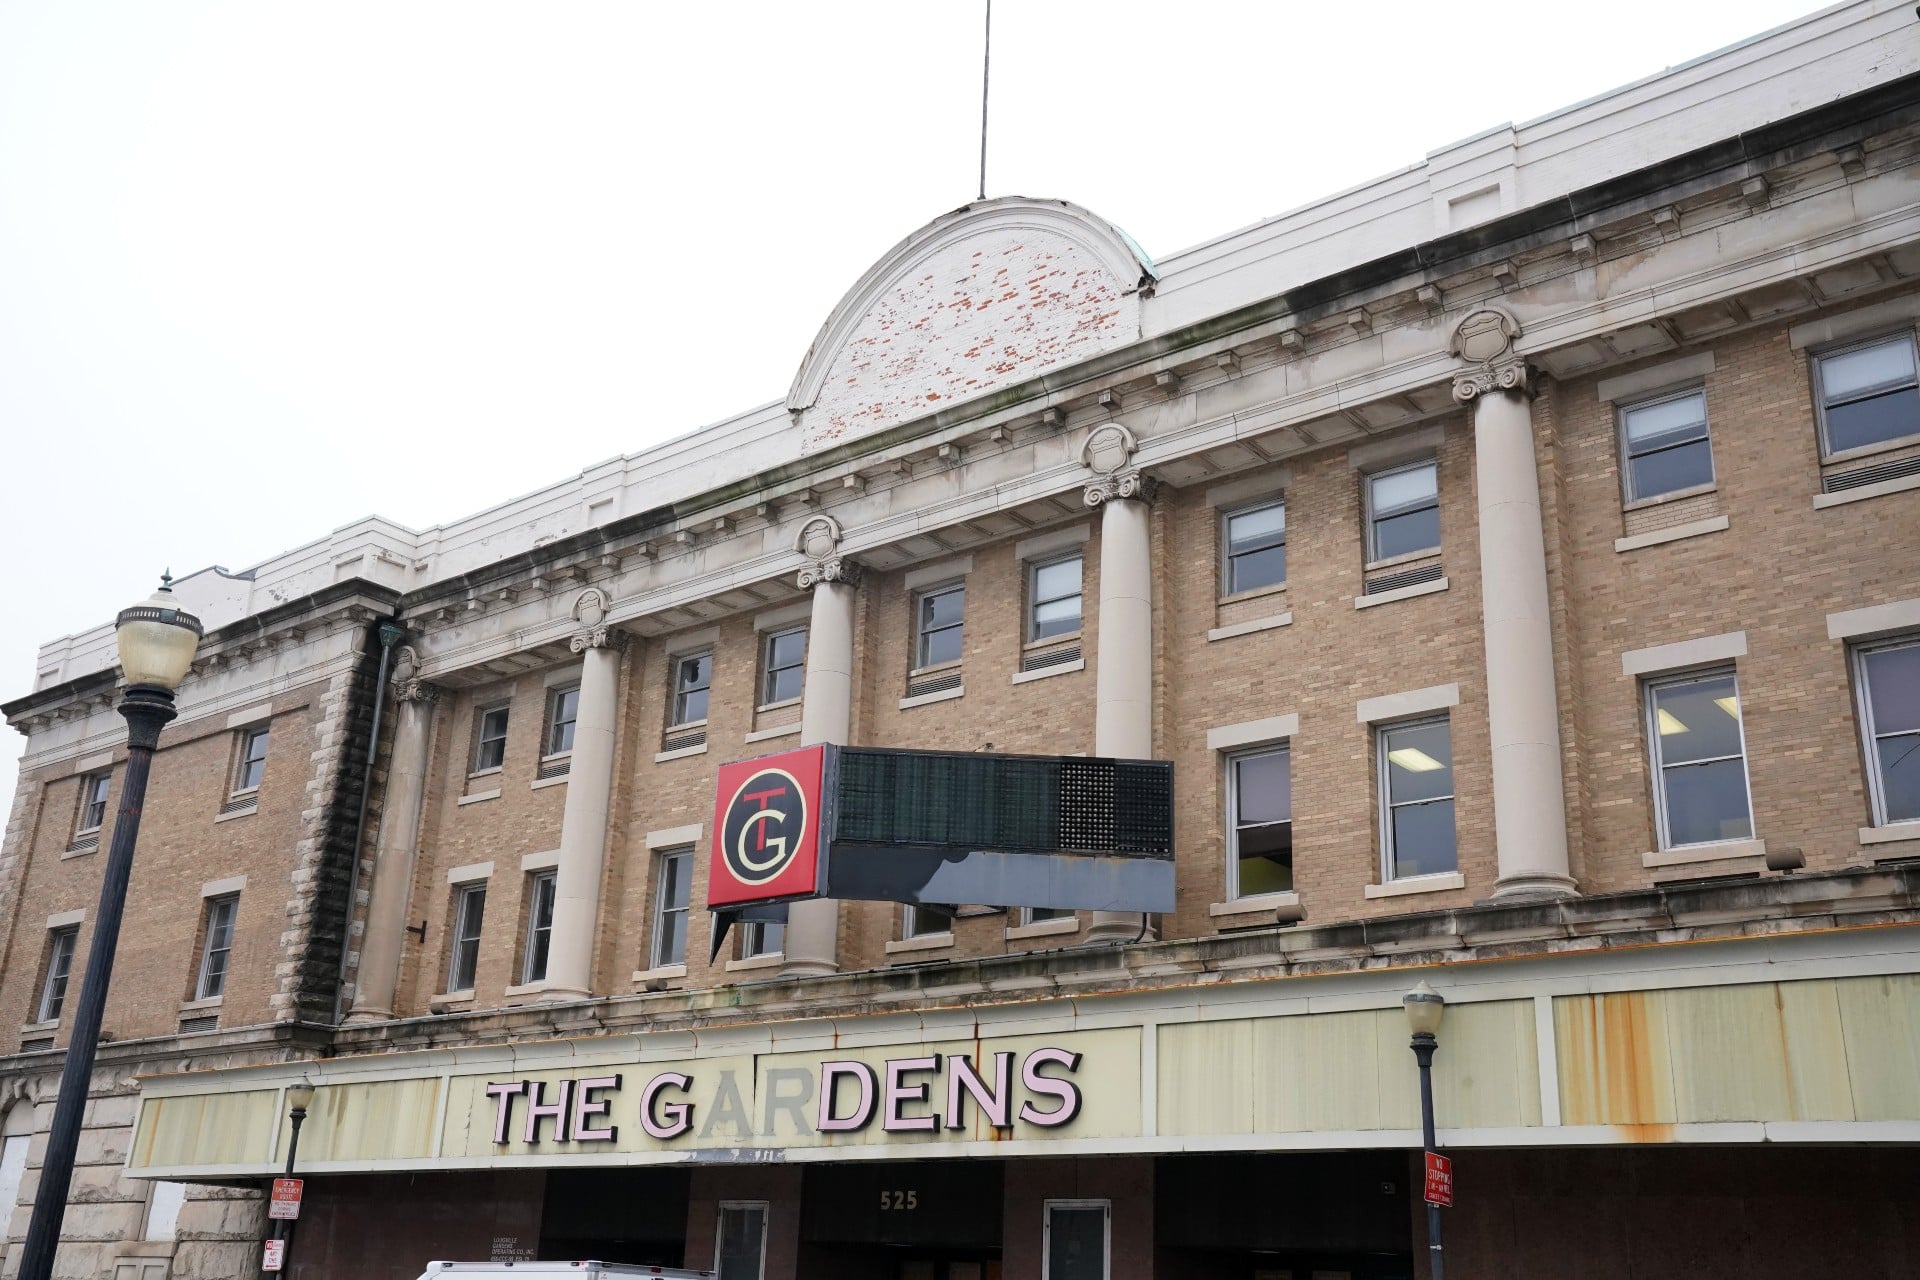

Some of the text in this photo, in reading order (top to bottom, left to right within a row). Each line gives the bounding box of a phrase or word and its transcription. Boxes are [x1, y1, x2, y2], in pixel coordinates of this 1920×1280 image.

[486, 1047, 1083, 1144] THE GARDENS
[1428, 1169, 1450, 1185] STOPPING
[880, 1190, 918, 1210] 525
